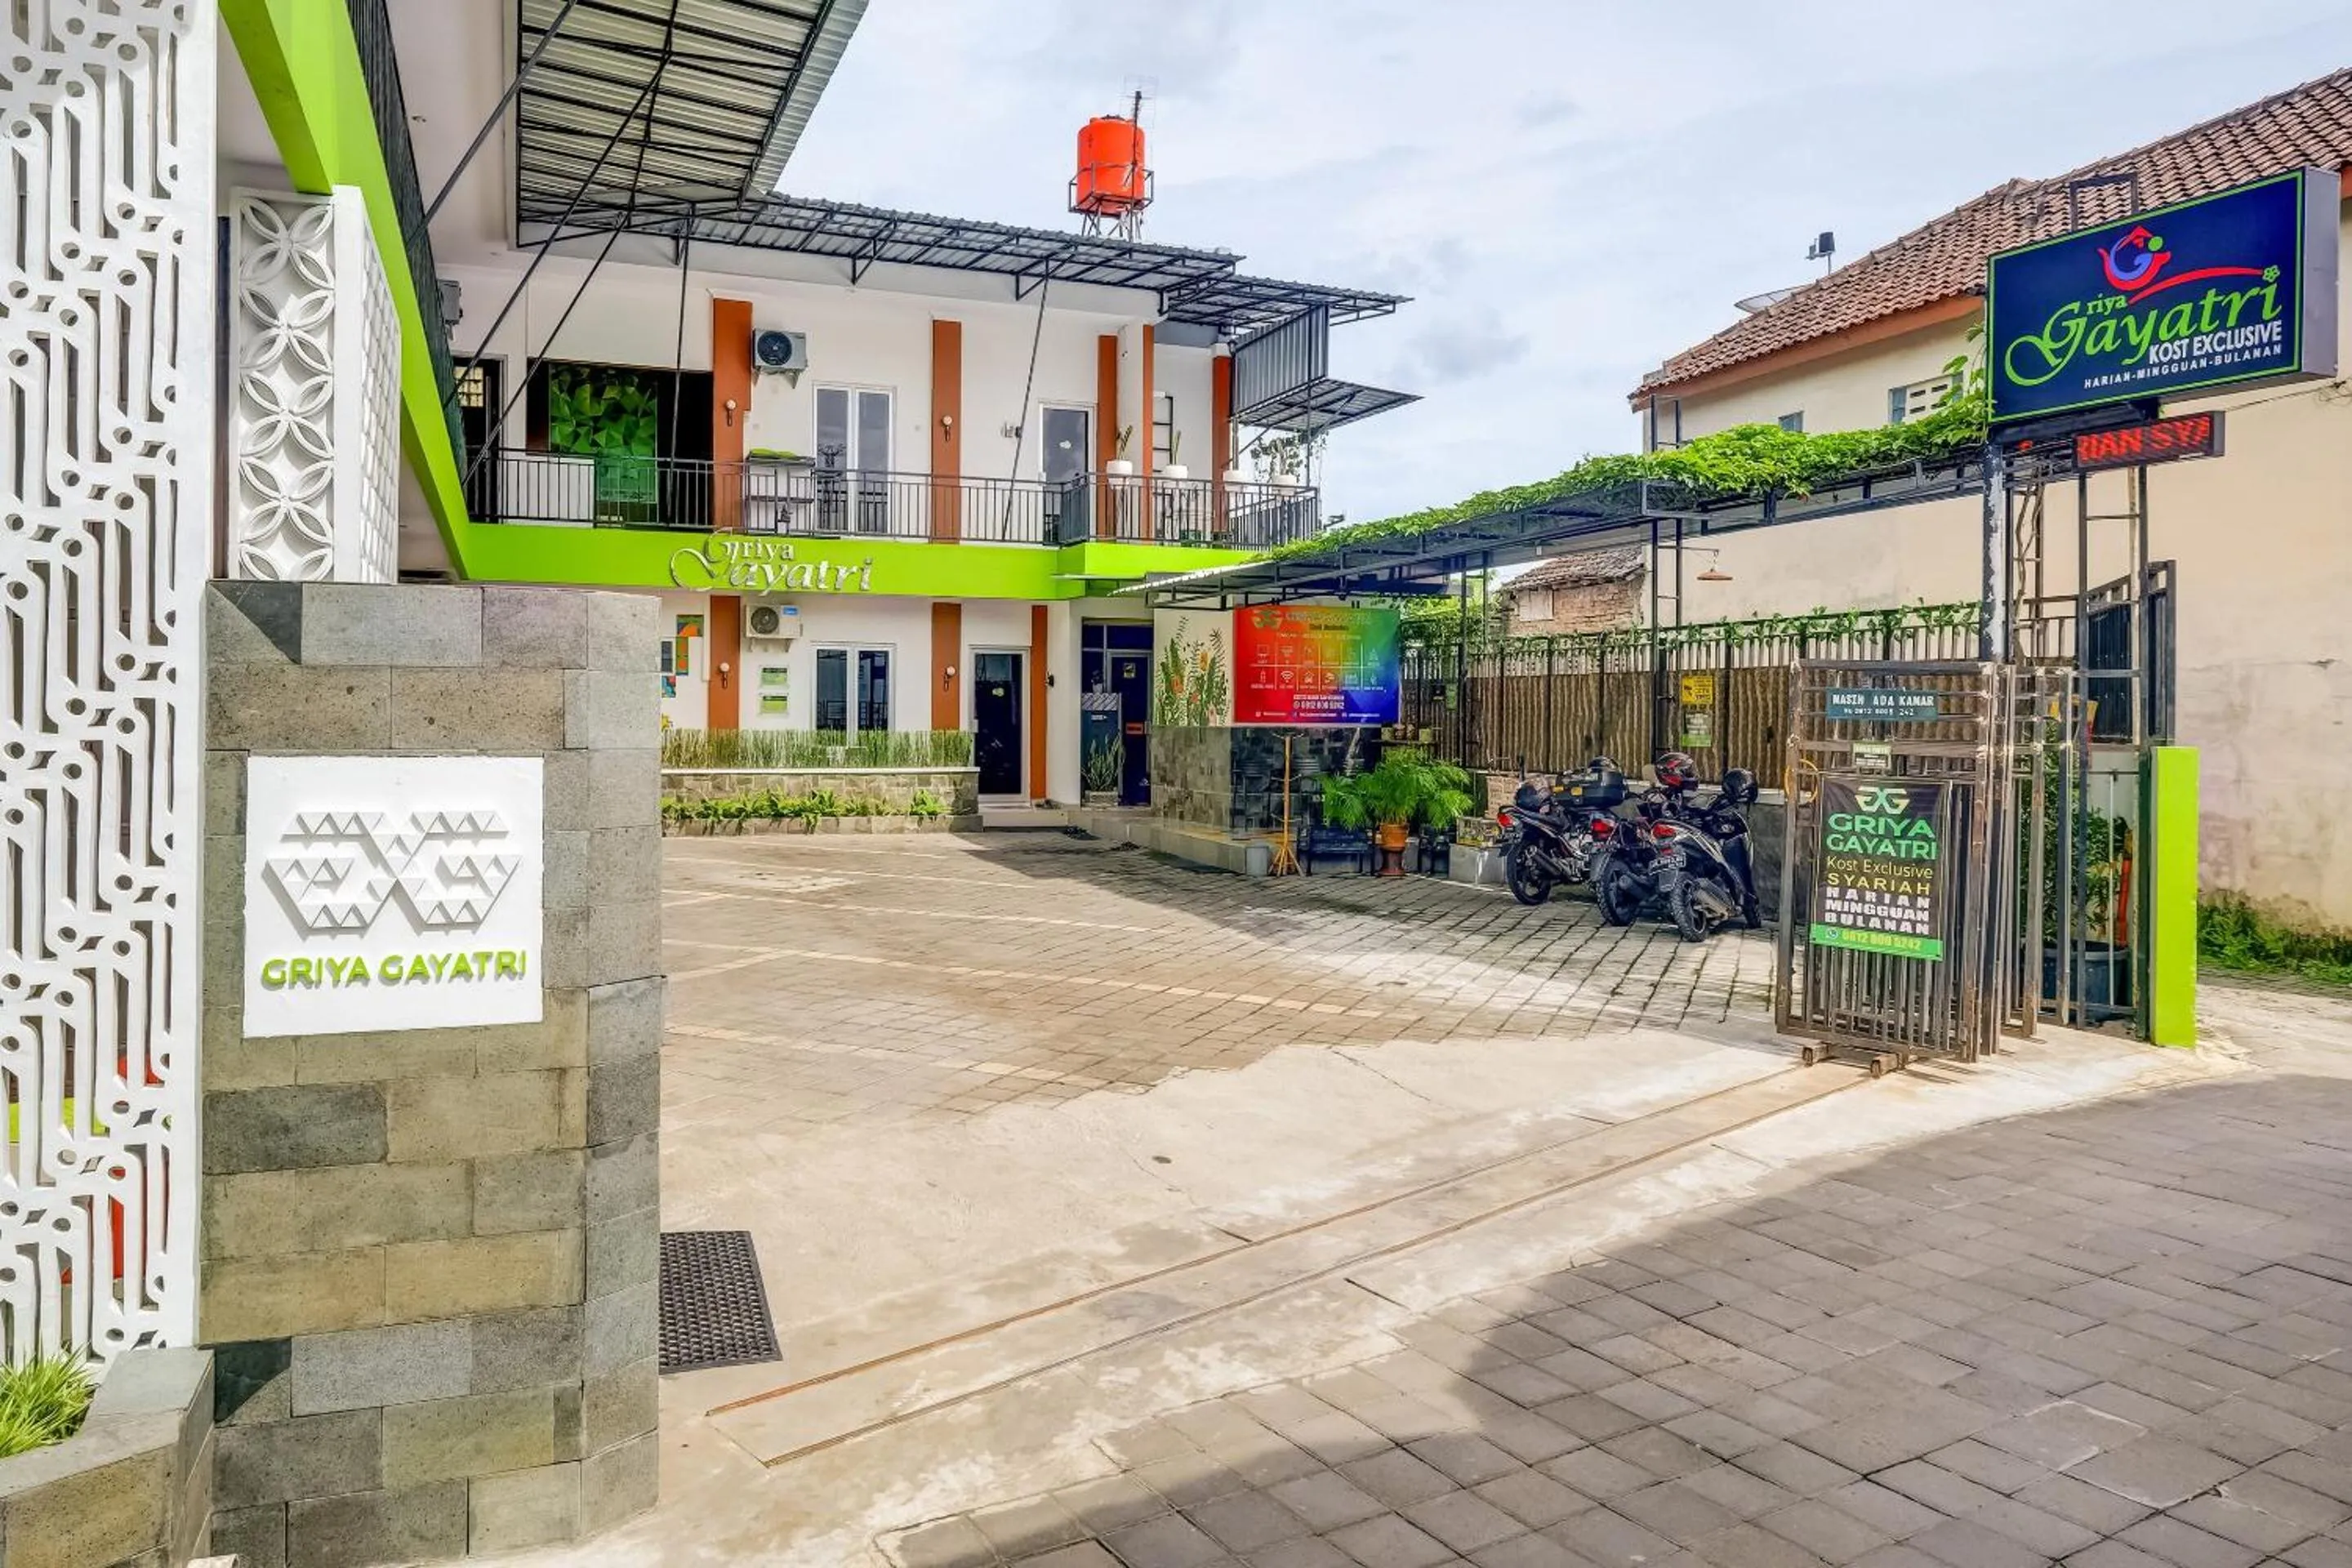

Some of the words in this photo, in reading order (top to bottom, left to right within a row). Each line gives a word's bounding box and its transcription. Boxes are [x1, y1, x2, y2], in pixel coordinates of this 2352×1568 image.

[2005, 282, 2283, 386] Gayatri
[2149, 338, 2190, 364] KOST
[2193, 319, 2283, 357] EXCLUSIVE
[1873, 695, 1895, 706] ADA
[1828, 813, 1936, 839] GRIYA
[1826, 833, 1938, 861] GAYATRI
[1826, 855, 1858, 872] Kost
[1863, 858, 1934, 880] Exclusive
[1827, 872, 1931, 896] SYARIAH
[1824, 899, 1930, 922] MINGGUAN
[1824, 911, 1930, 935] BULANAN
[261, 956, 371, 989] GRIYA
[378, 950, 528, 983] GAYATRI
